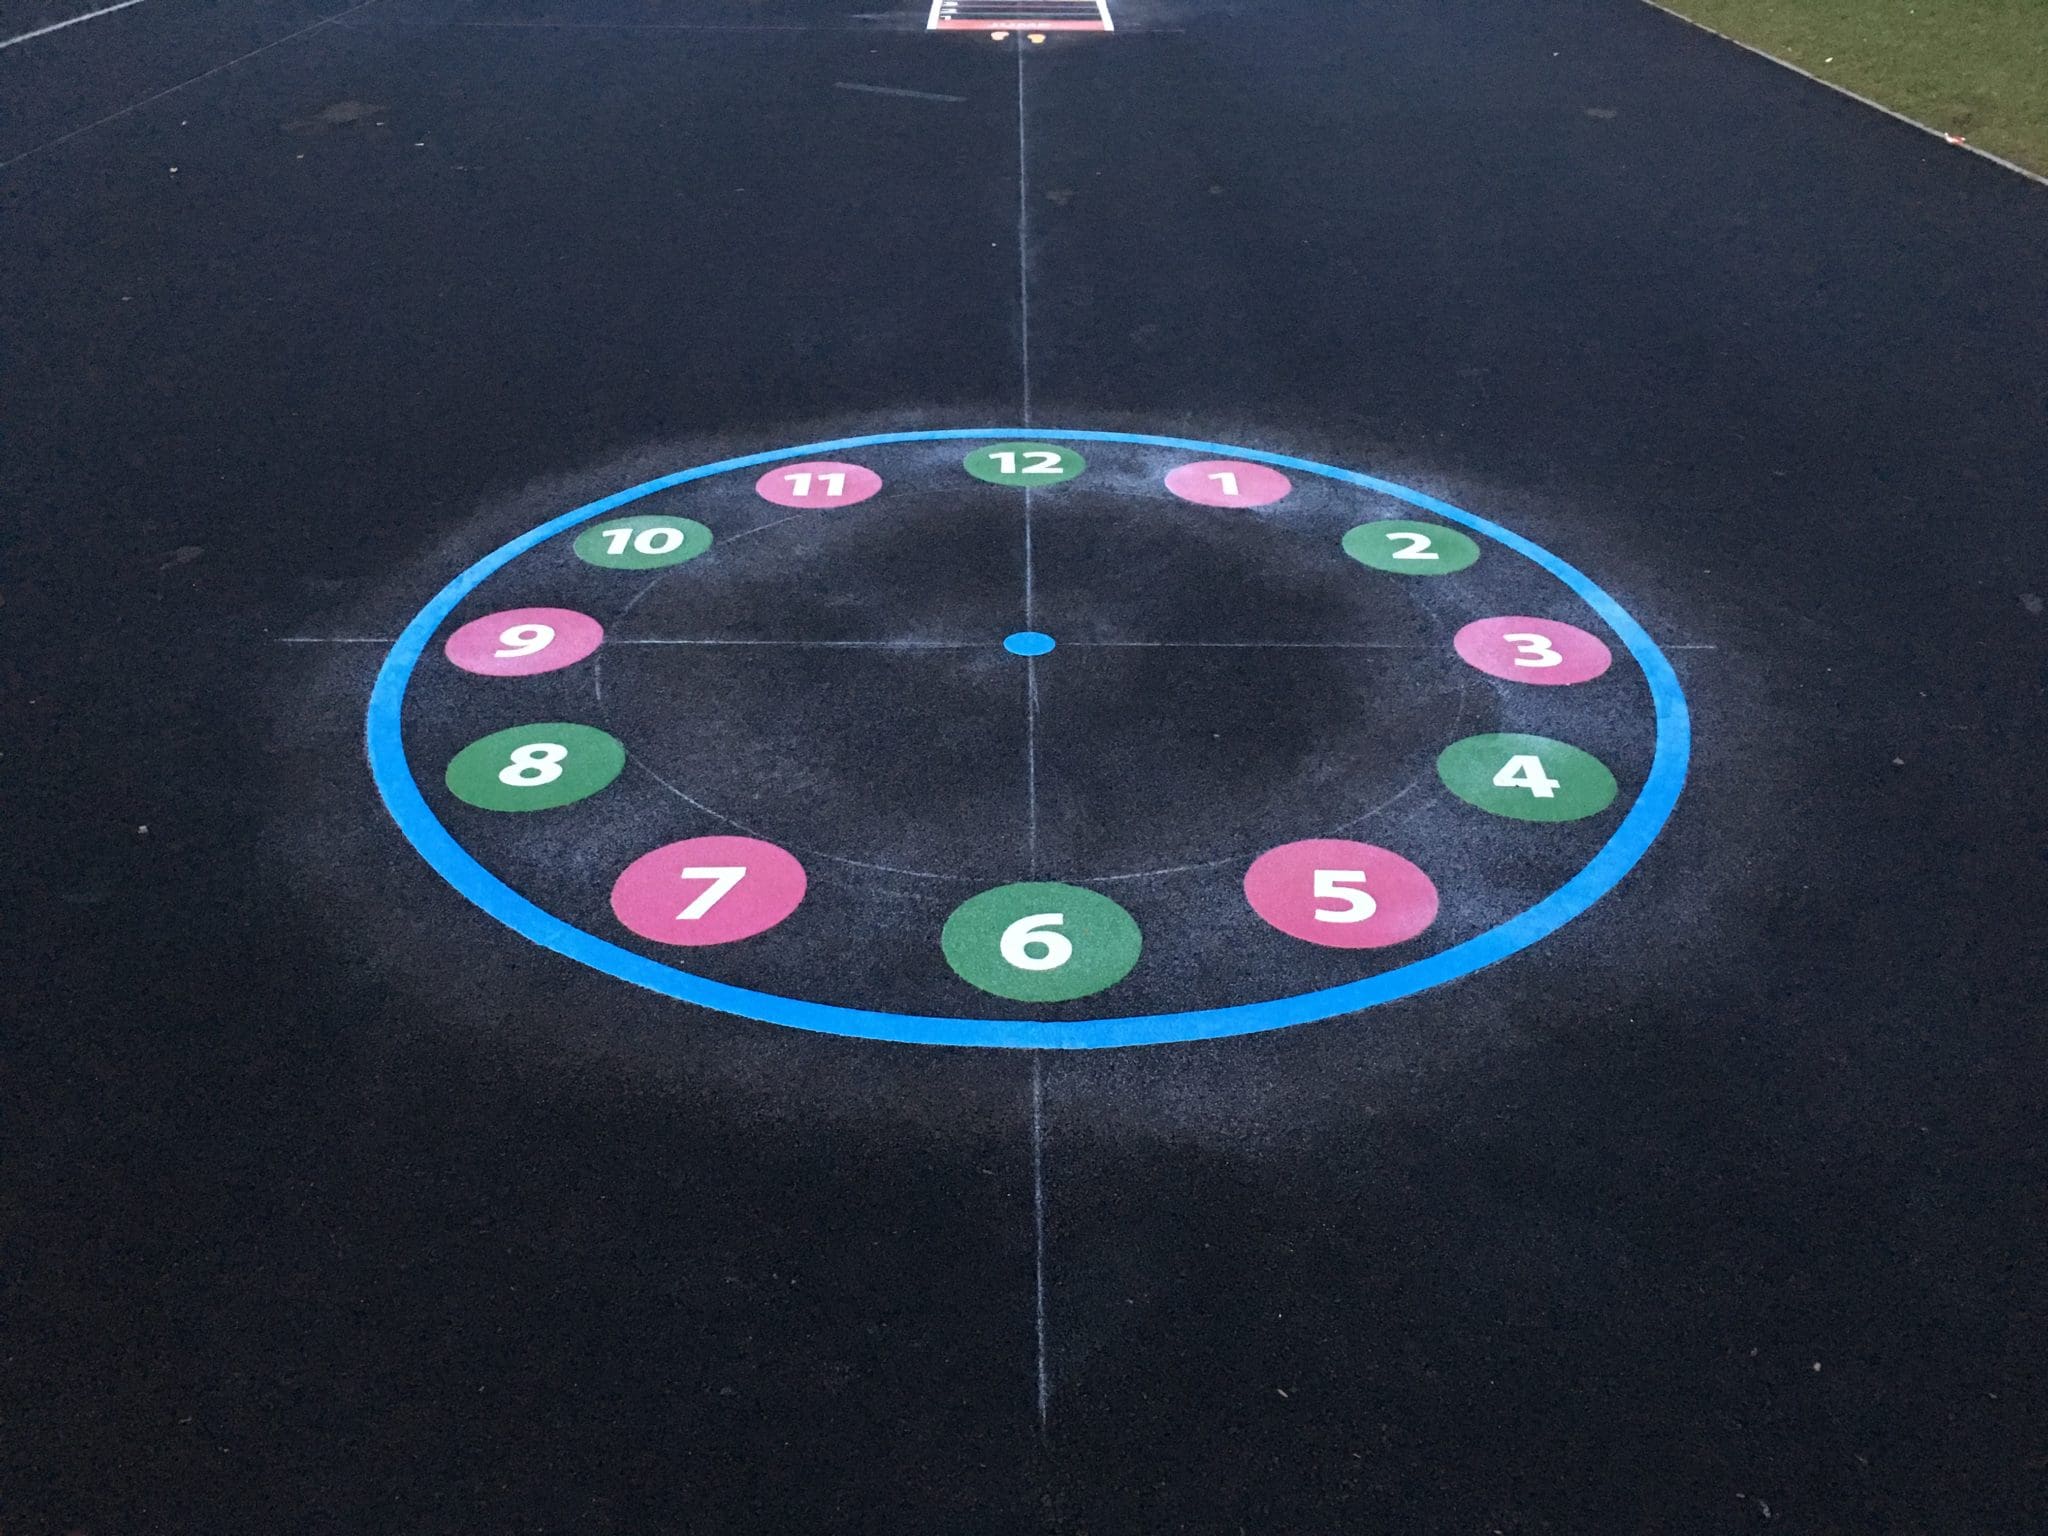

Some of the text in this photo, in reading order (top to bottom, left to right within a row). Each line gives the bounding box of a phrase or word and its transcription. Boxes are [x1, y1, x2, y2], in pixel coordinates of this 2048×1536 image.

[989, 451, 1064, 475] 12
[784, 472, 847, 496] 11
[1208, 471, 1240, 496] 1
[603, 528, 685, 555] 10
[1386, 532, 1440, 560] 2
[494, 624, 556, 658] 9
[1503, 632, 1563, 669] 3
[499, 743, 568, 787] 8
[1493, 755, 1561, 798] 4
[676, 867, 747, 921] 7
[1314, 870, 1377, 924] 5
[1000, 913, 1073, 972] 6
